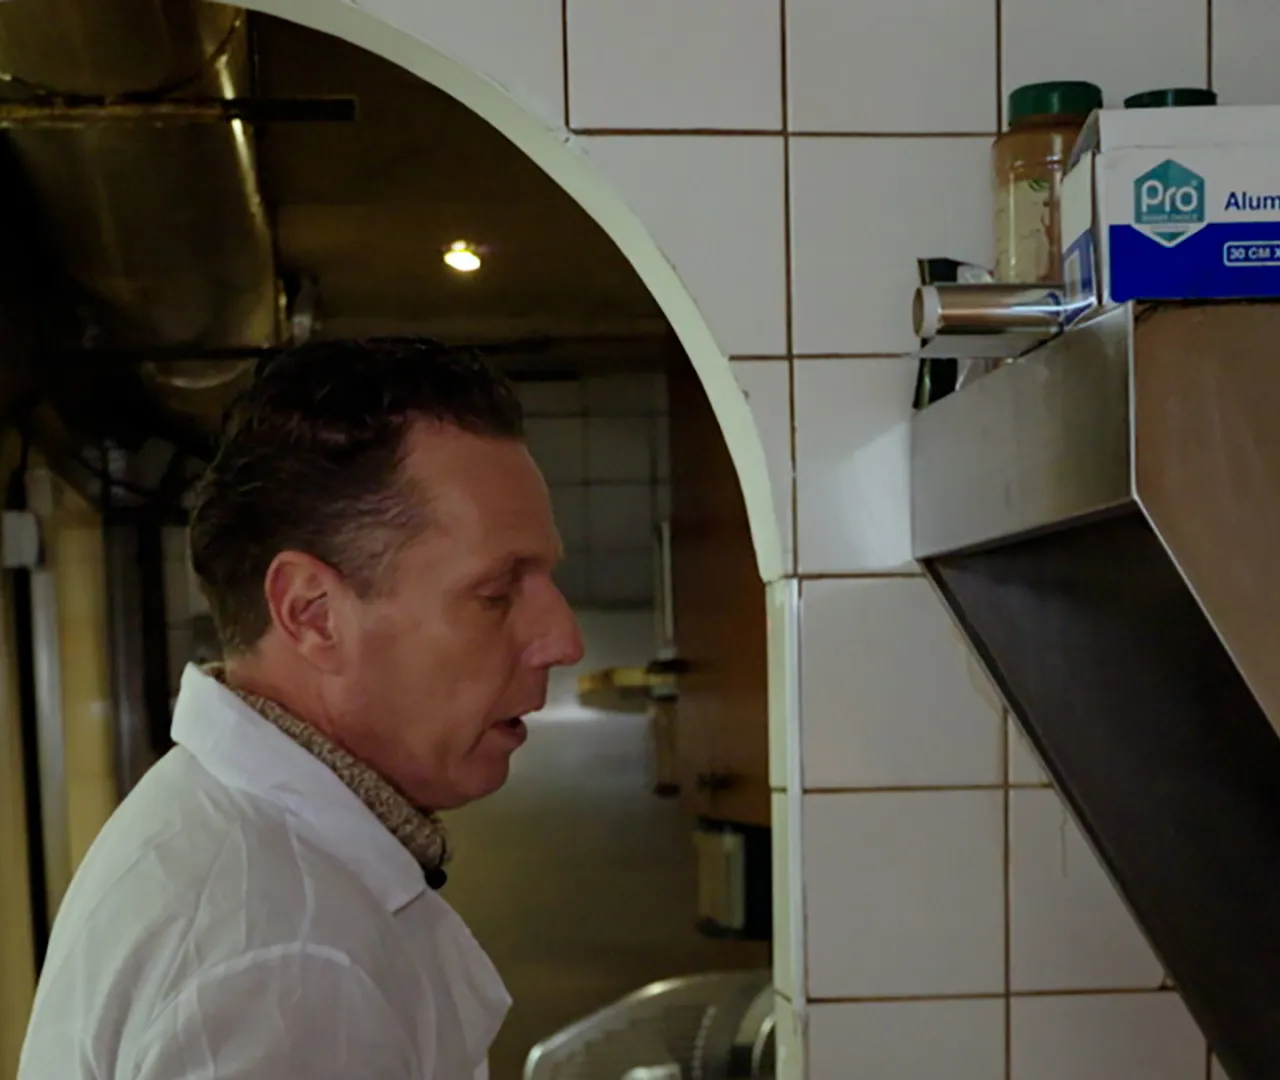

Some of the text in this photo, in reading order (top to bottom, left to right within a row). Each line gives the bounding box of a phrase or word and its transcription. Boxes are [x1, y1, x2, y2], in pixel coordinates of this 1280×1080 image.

[1141, 179, 1198, 212] Pro
[1229, 247, 1246, 259] 30
[1248, 247, 1271, 259] CM
